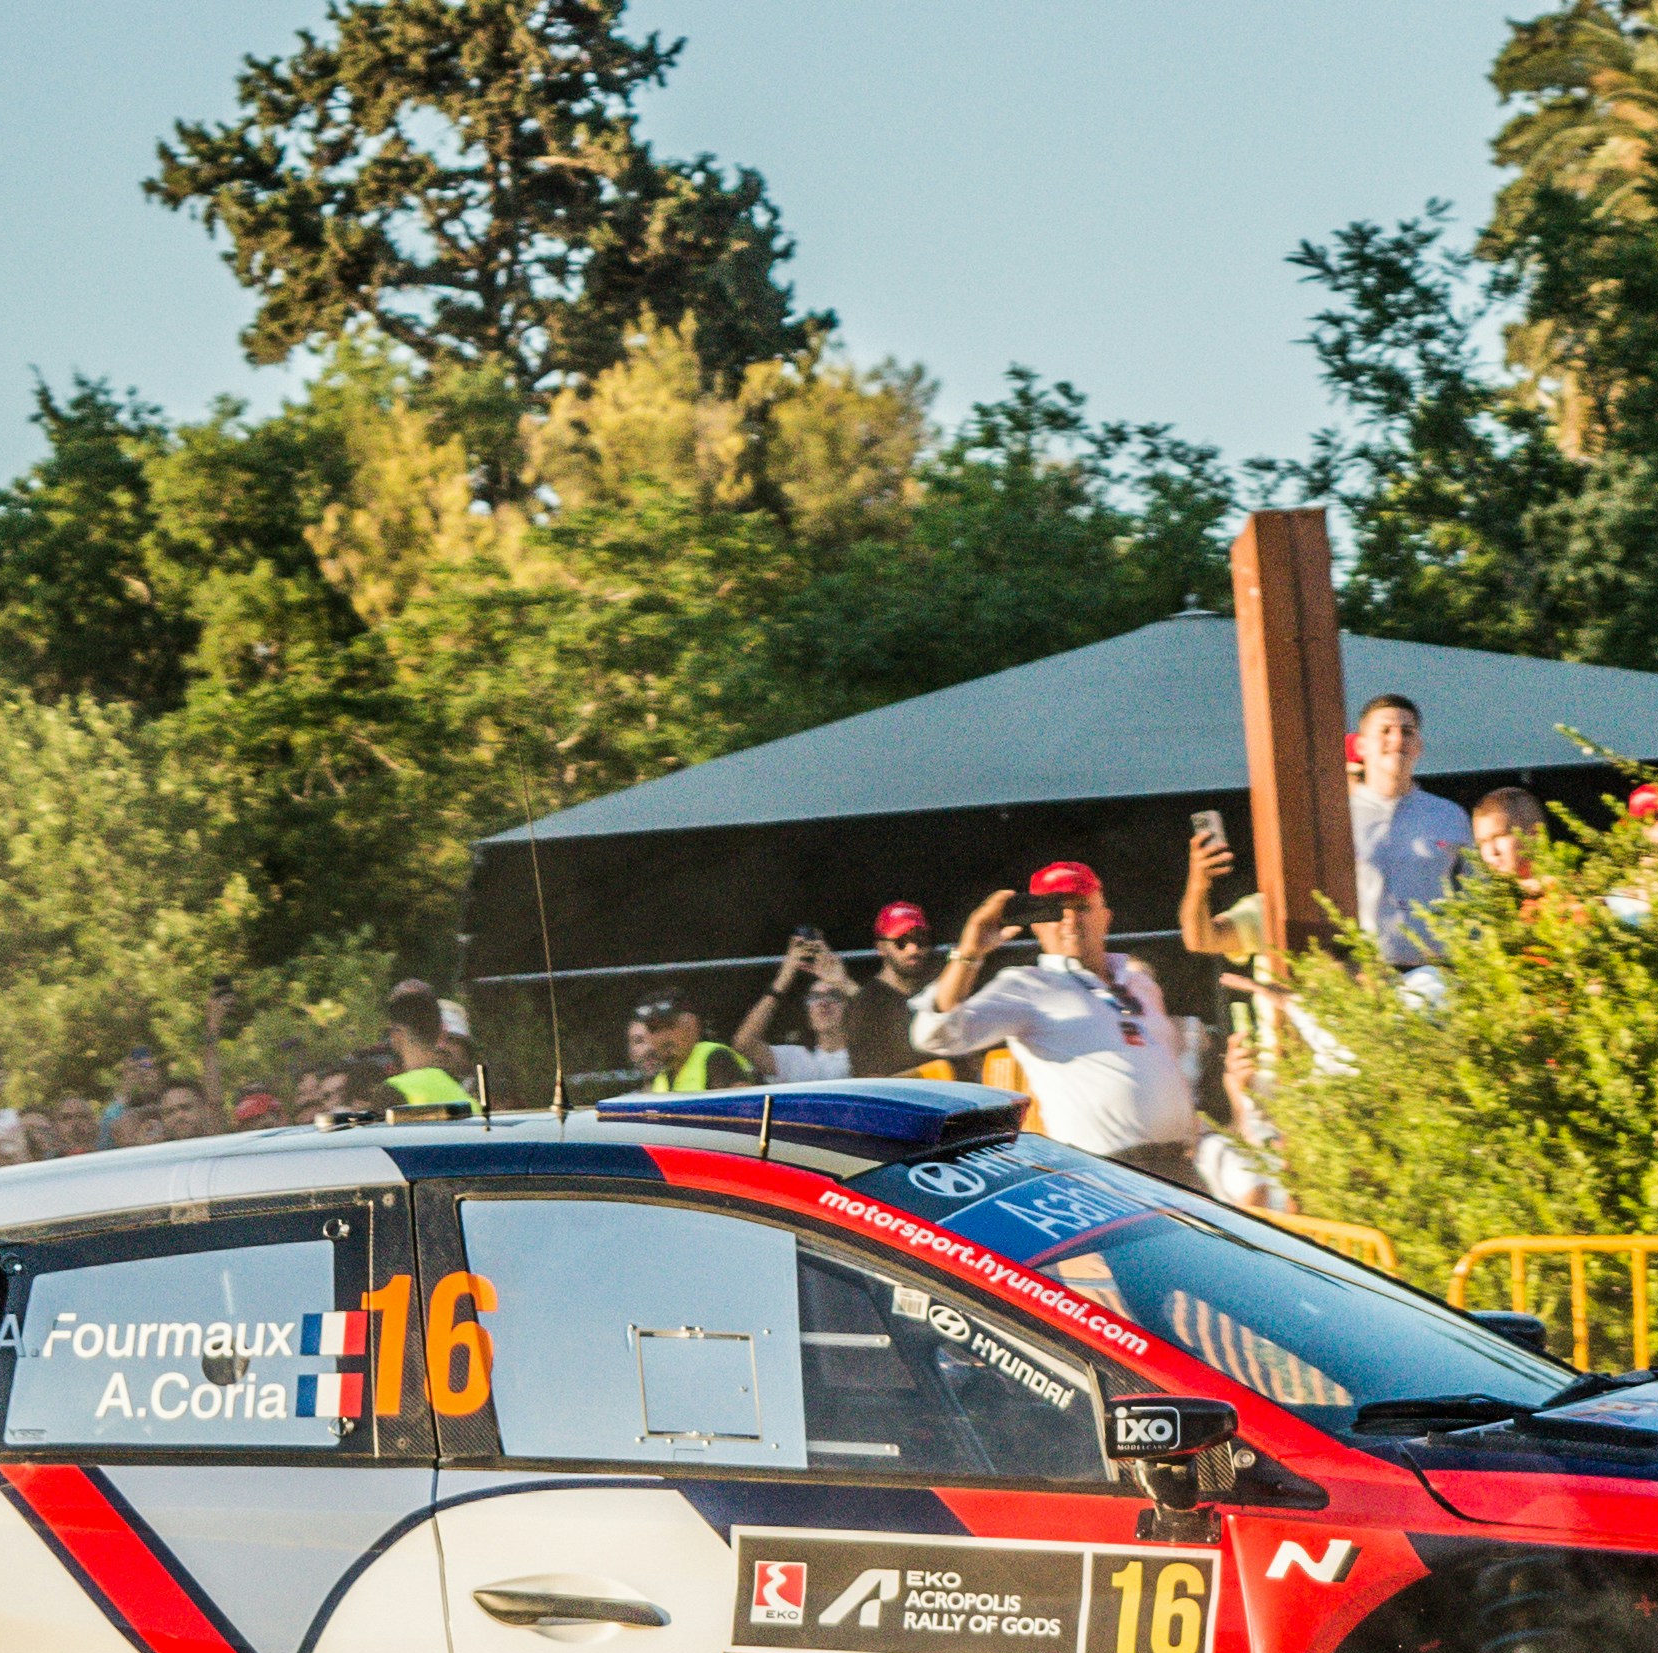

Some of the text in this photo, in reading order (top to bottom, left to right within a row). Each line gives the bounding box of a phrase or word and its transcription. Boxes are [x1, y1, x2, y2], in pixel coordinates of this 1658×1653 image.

[818, 1189, 1149, 1356] motorsport.hyundai.com
[360, 1270, 499, 1417] 16
[971, 1332, 1077, 1410] HYUNDAI
[94, 1371, 288, 1420] A.Coria
[906, 1570, 962, 1589] EKO
[765, 1609, 800, 1621] EKO
[904, 1590, 1022, 1613] ACROPOLIS
[903, 1611, 1062, 1637] RALLY OF GODS
